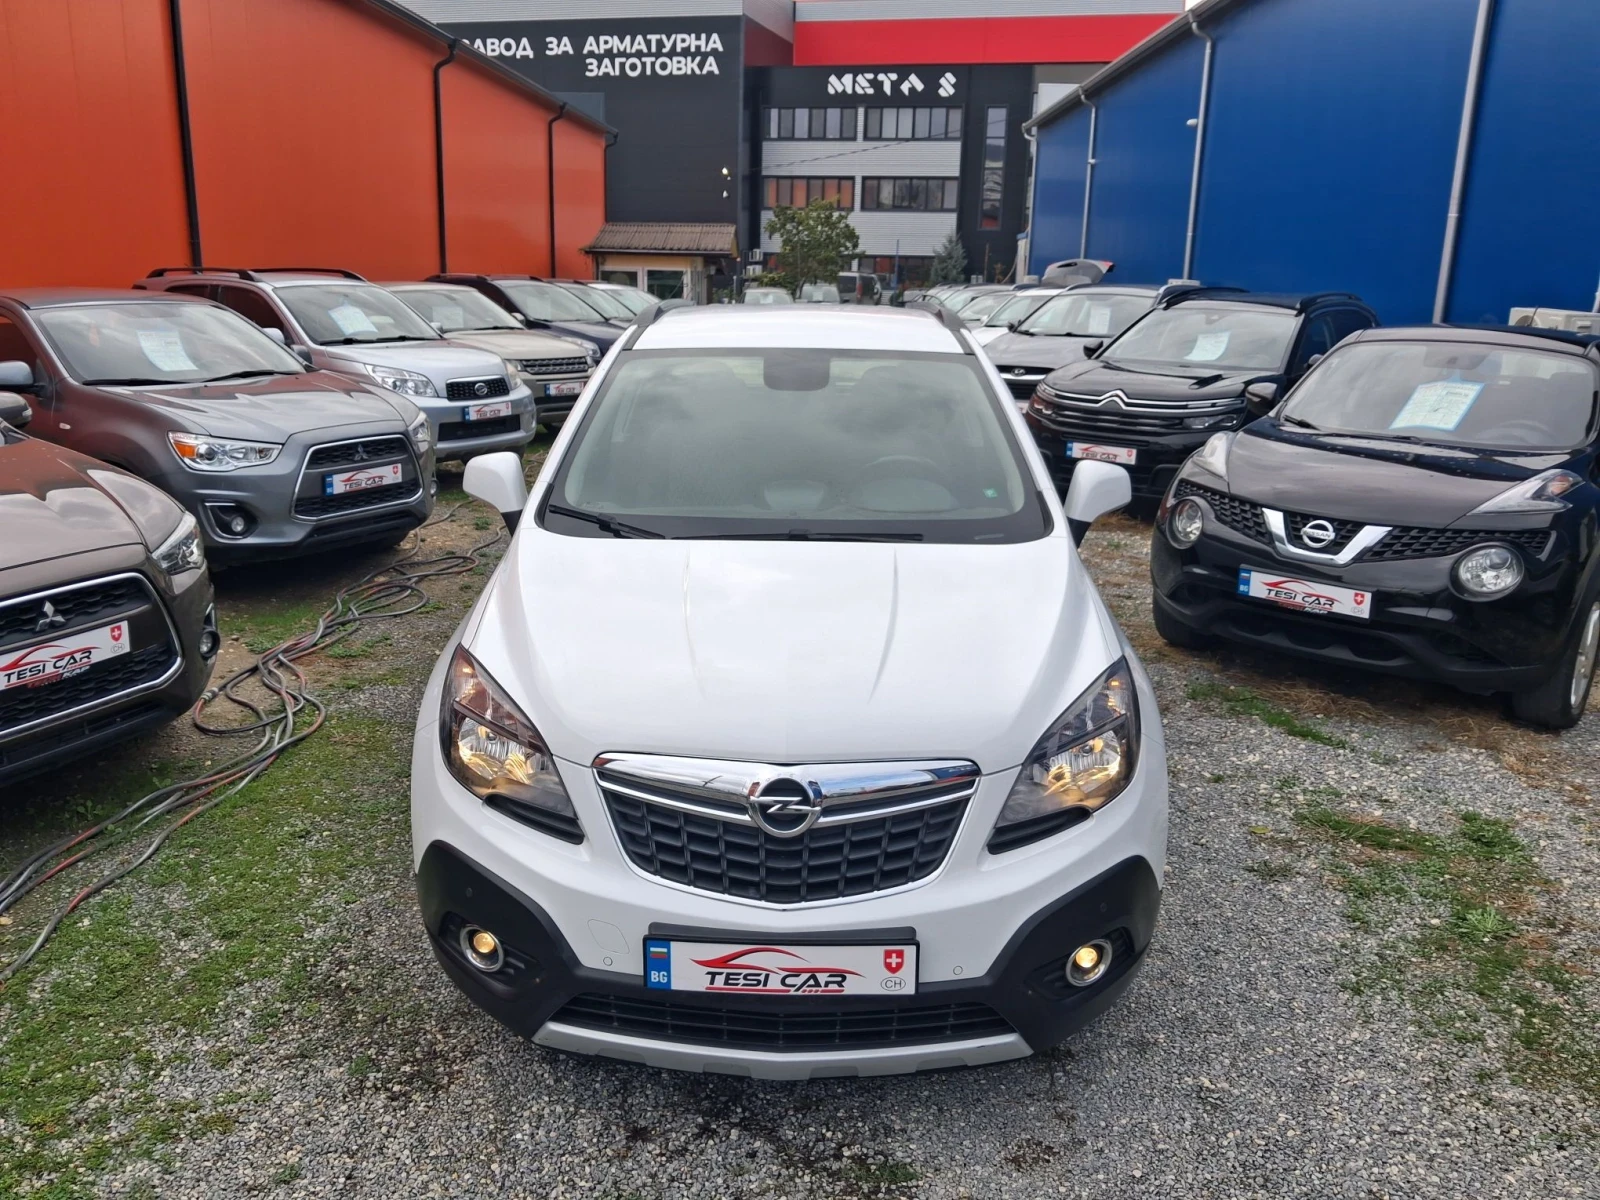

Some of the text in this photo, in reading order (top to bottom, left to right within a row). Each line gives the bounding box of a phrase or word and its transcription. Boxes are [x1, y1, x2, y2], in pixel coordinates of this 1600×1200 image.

[545, 36, 574, 56] ЗА
[583, 33, 724, 54] АРМАТУРНА
[585, 56, 720, 77] ЗАГОТОВКА
[1100, 453, 1118, 461] CAR
[343, 480, 363, 489] TESI
[364, 477, 384, 487] CAR
[1303, 530, 1333, 539] NISSAN
[1239, 584, 1249, 592] BG
[1266, 588, 1297, 600] TESI
[1302, 596, 1335, 608] CAR
[4, 663, 46, 683] TESI
[53, 650, 92, 670] CAR
[650, 971, 668, 983] BG
[705, 971, 847, 992] TESI CAR
[884, 980, 902, 988] CH
